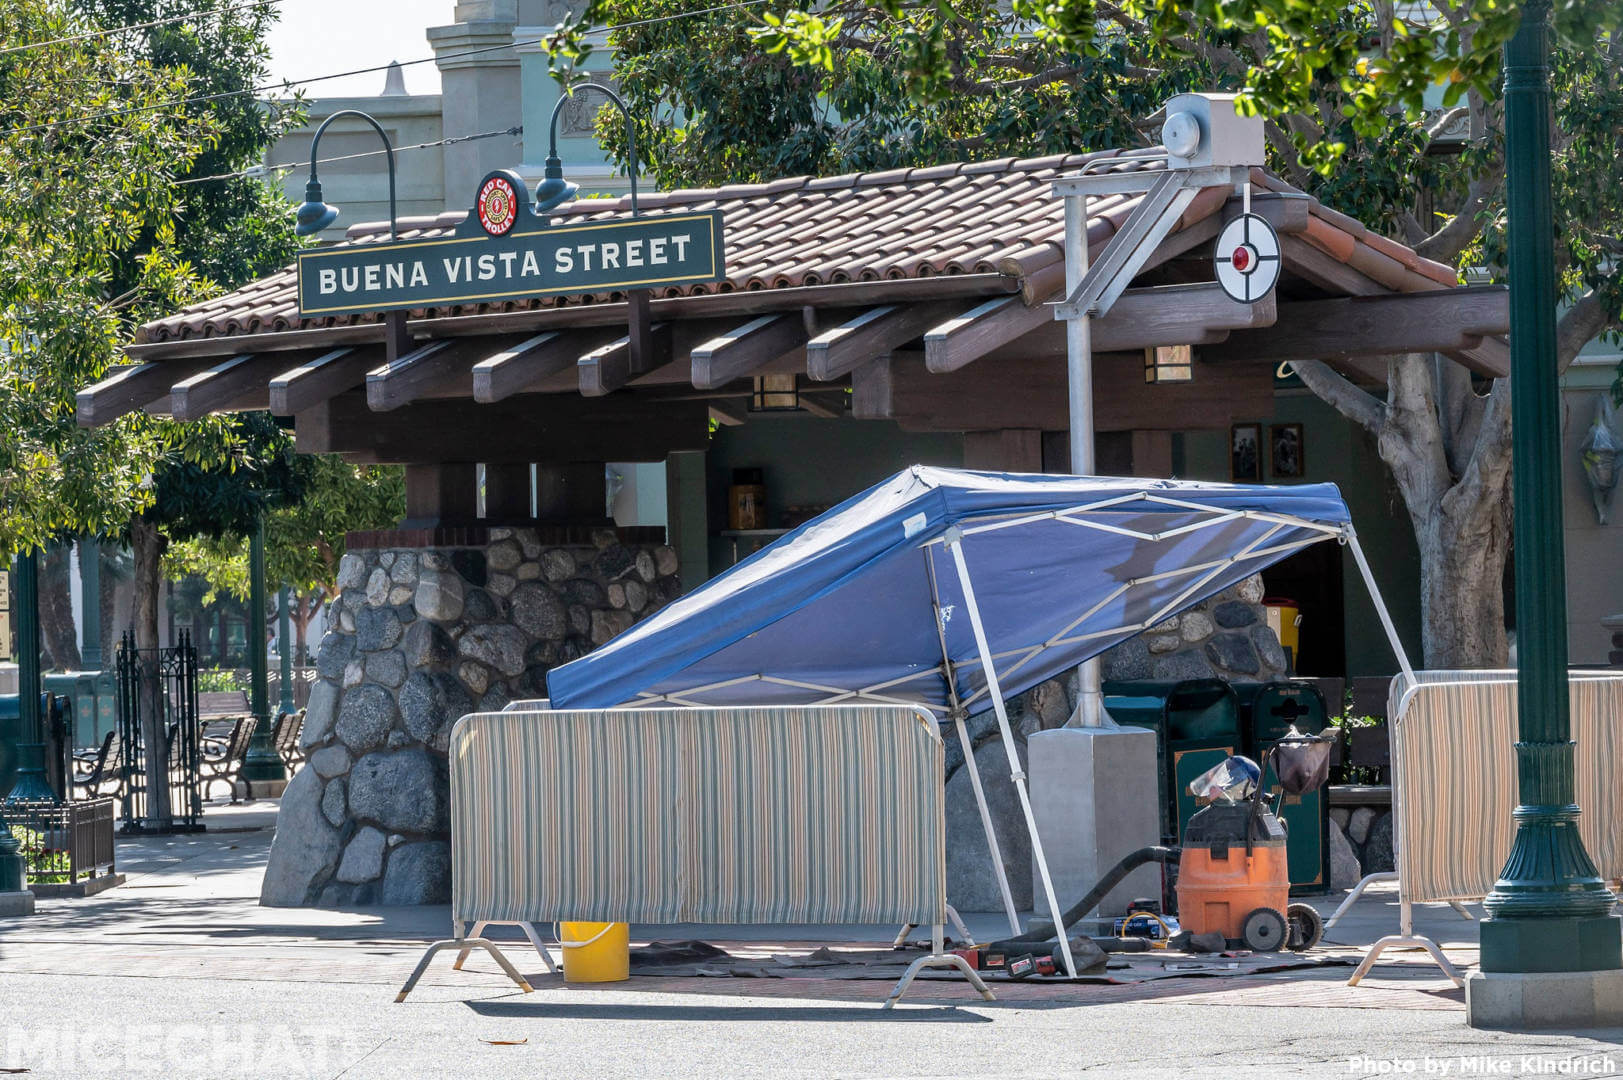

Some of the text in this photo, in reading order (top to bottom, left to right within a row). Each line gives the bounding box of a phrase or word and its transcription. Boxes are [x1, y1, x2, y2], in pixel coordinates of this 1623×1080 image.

[480, 179, 513, 203] RED CAR
[482, 211, 514, 233] TROLLEY
[319, 233, 691, 295] BUENA VISTA STREET
